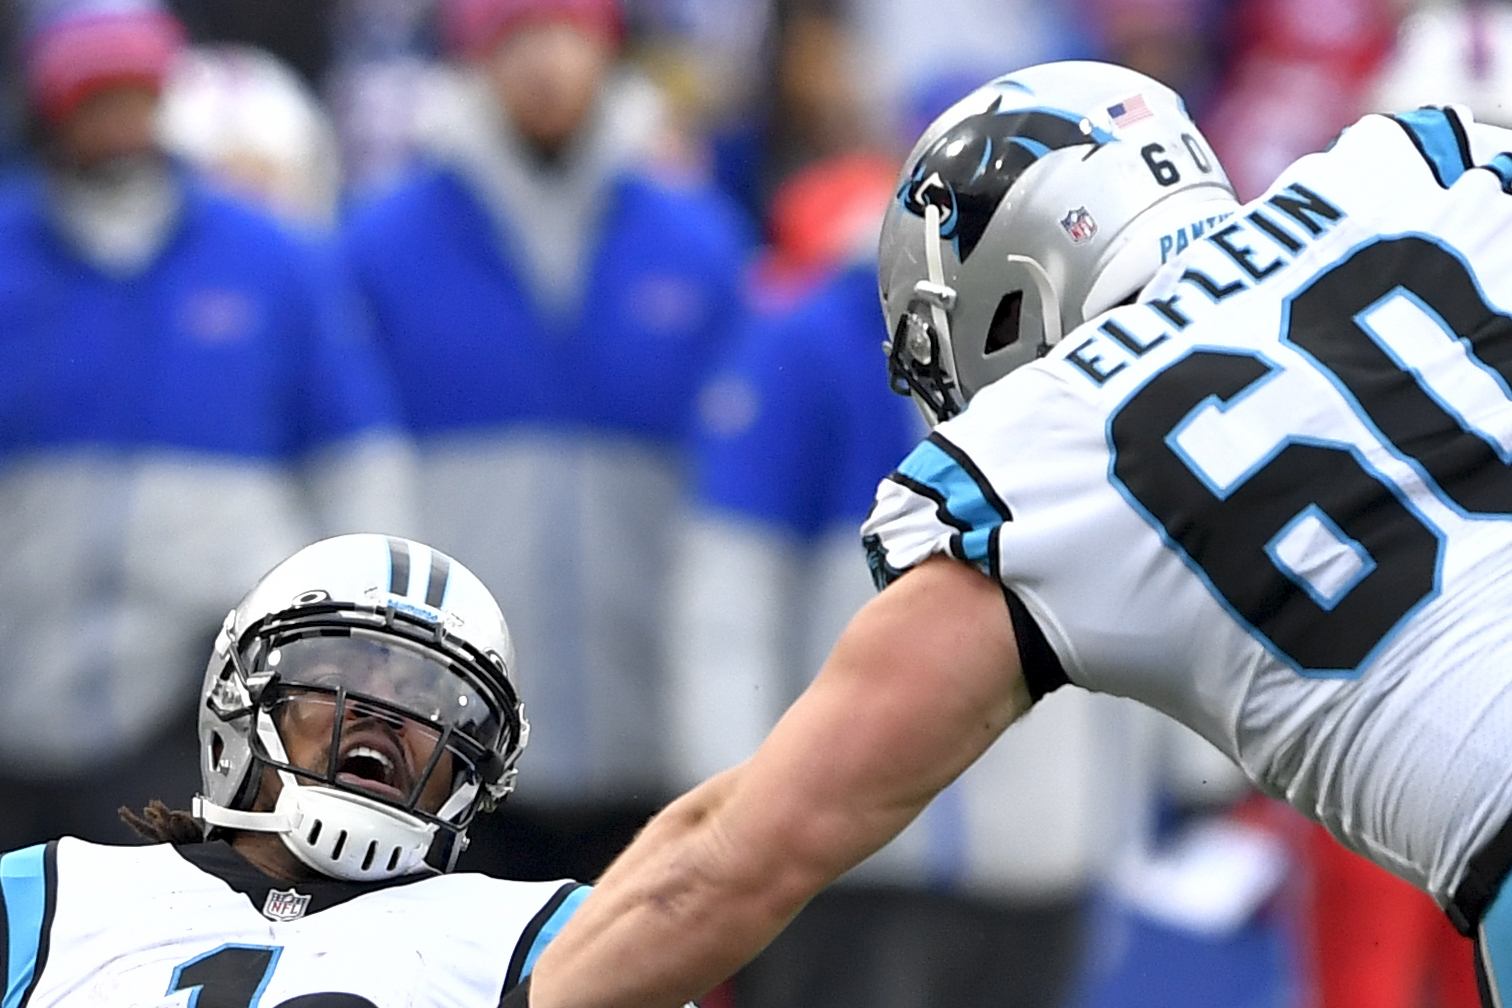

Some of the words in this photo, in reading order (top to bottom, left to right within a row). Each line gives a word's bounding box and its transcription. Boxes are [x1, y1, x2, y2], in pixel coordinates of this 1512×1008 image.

[1140, 132, 1213, 187] 60
[1063, 181, 1349, 388] ELFLEIN
[1105, 231, 1512, 680] 60
